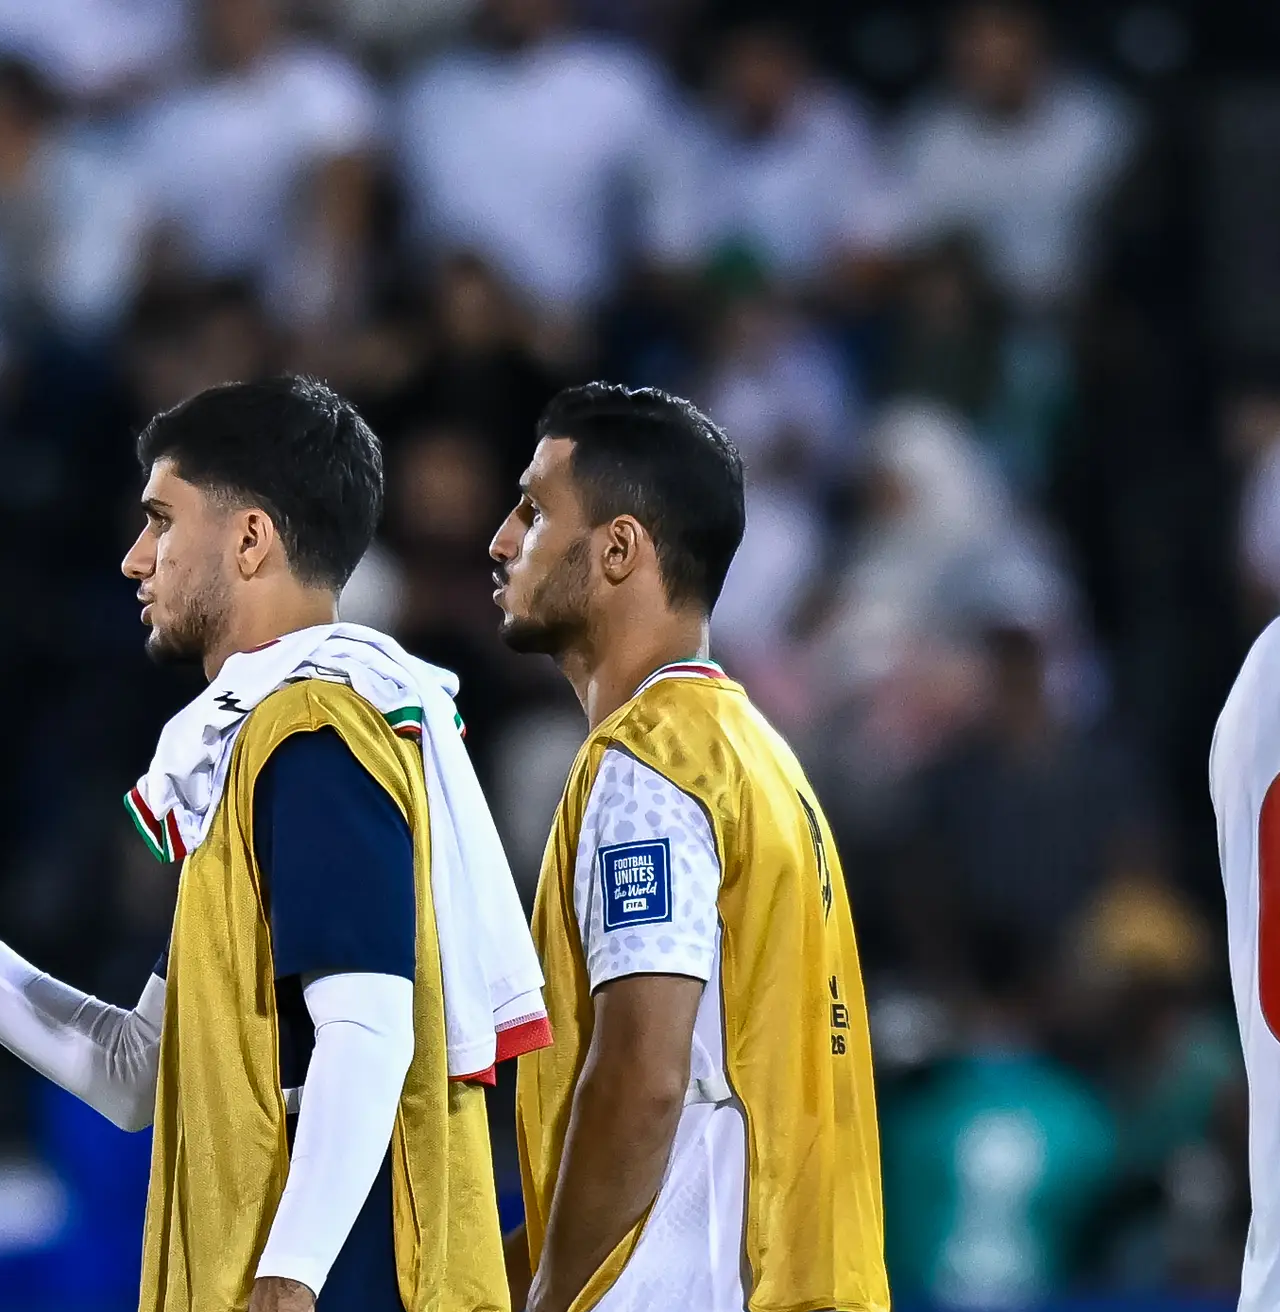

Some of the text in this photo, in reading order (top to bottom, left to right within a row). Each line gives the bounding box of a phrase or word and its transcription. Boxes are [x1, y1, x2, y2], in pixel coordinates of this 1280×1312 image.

[613, 855, 654, 870] FOOTBALL
[614, 866, 655, 886] UNITES
[627, 881, 658, 897] World
